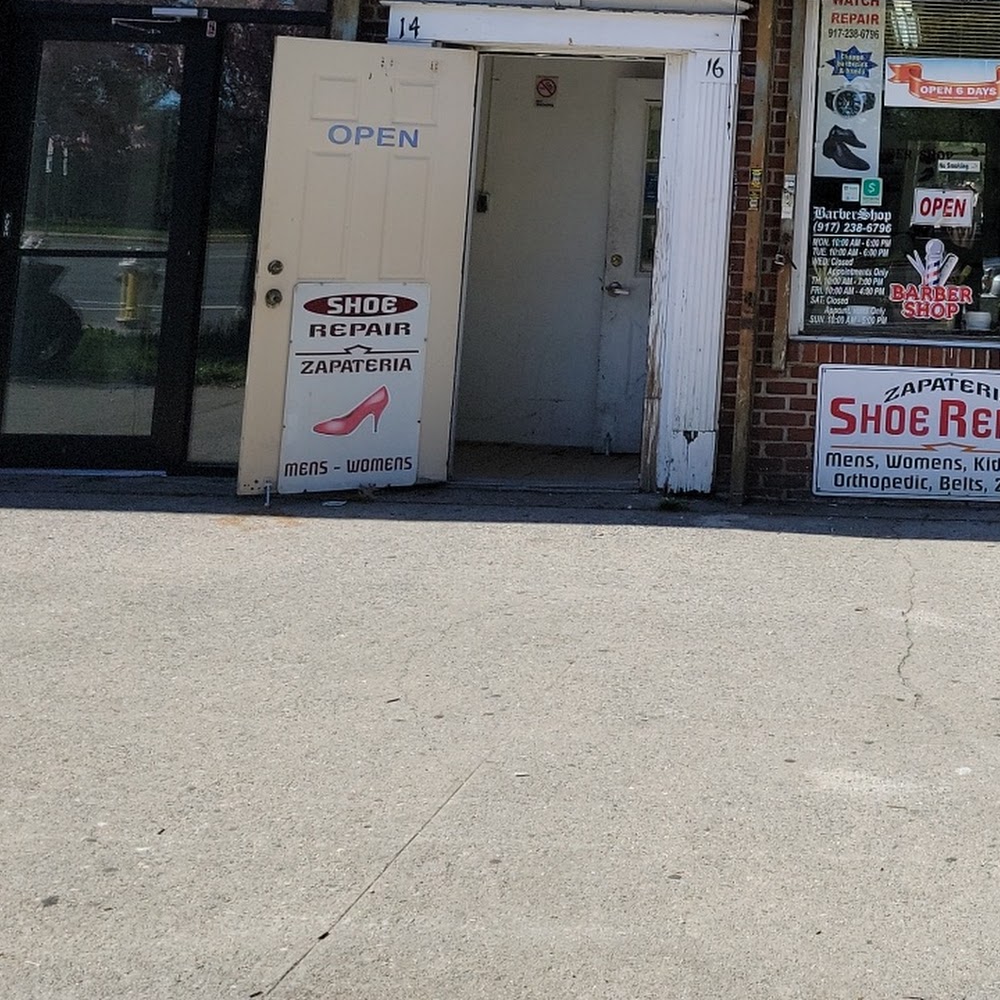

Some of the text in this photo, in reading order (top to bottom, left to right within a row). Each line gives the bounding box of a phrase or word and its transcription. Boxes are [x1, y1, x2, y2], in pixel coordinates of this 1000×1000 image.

[831, 12, 879, 25] REPAIR
[399, 16, 421, 39] 14
[706, 57, 724, 79] 16
[920, 86, 998, 96] OPEN 6 DAYS
[328, 124, 418, 148] OPEN
[920, 197, 966, 217] OPEN
[813, 221, 892, 233] (917) 238-6796
[880, 239, 892, 247] PM
[878, 249, 889, 257] PM
[831, 258, 854, 266] Closed
[873, 268, 889, 278] Only
[873, 277, 884, 286] PM
[874, 287, 885, 295] PM
[890, 283, 973, 303] BARBER
[327, 297, 398, 314] SHOE
[826, 296, 849, 305] Closed
[902, 302, 959, 319] SHOP
[309, 322, 411, 337] REPAIR
[300, 358, 412, 374] ZAPATERIA
[829, 397, 930, 436] SHOE
[284, 461, 328, 477] MENS
[347, 457, 413, 473] WOMENS
[825, 452, 879, 469] Mens,
[886, 454, 967, 473] Womens,
[834, 473, 933, 491] Orthopedic,
[940, 476, 988, 493] Belts,
